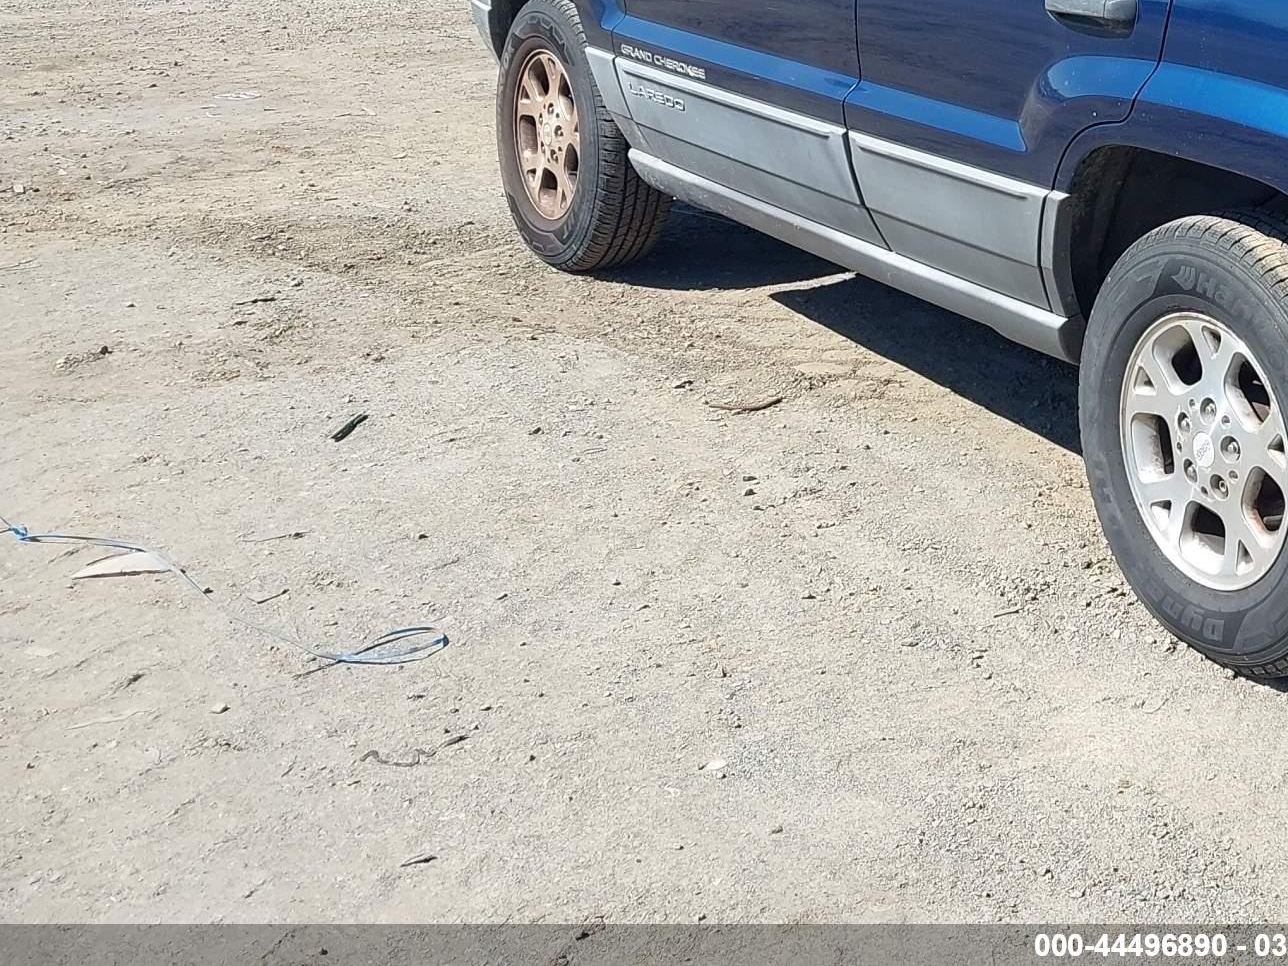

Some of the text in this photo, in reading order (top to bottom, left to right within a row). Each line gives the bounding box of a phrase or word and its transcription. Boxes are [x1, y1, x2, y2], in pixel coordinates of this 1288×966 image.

[621, 43, 707, 80] GRAND CHEROKEE
[628, 81, 686, 112] LAREDO
